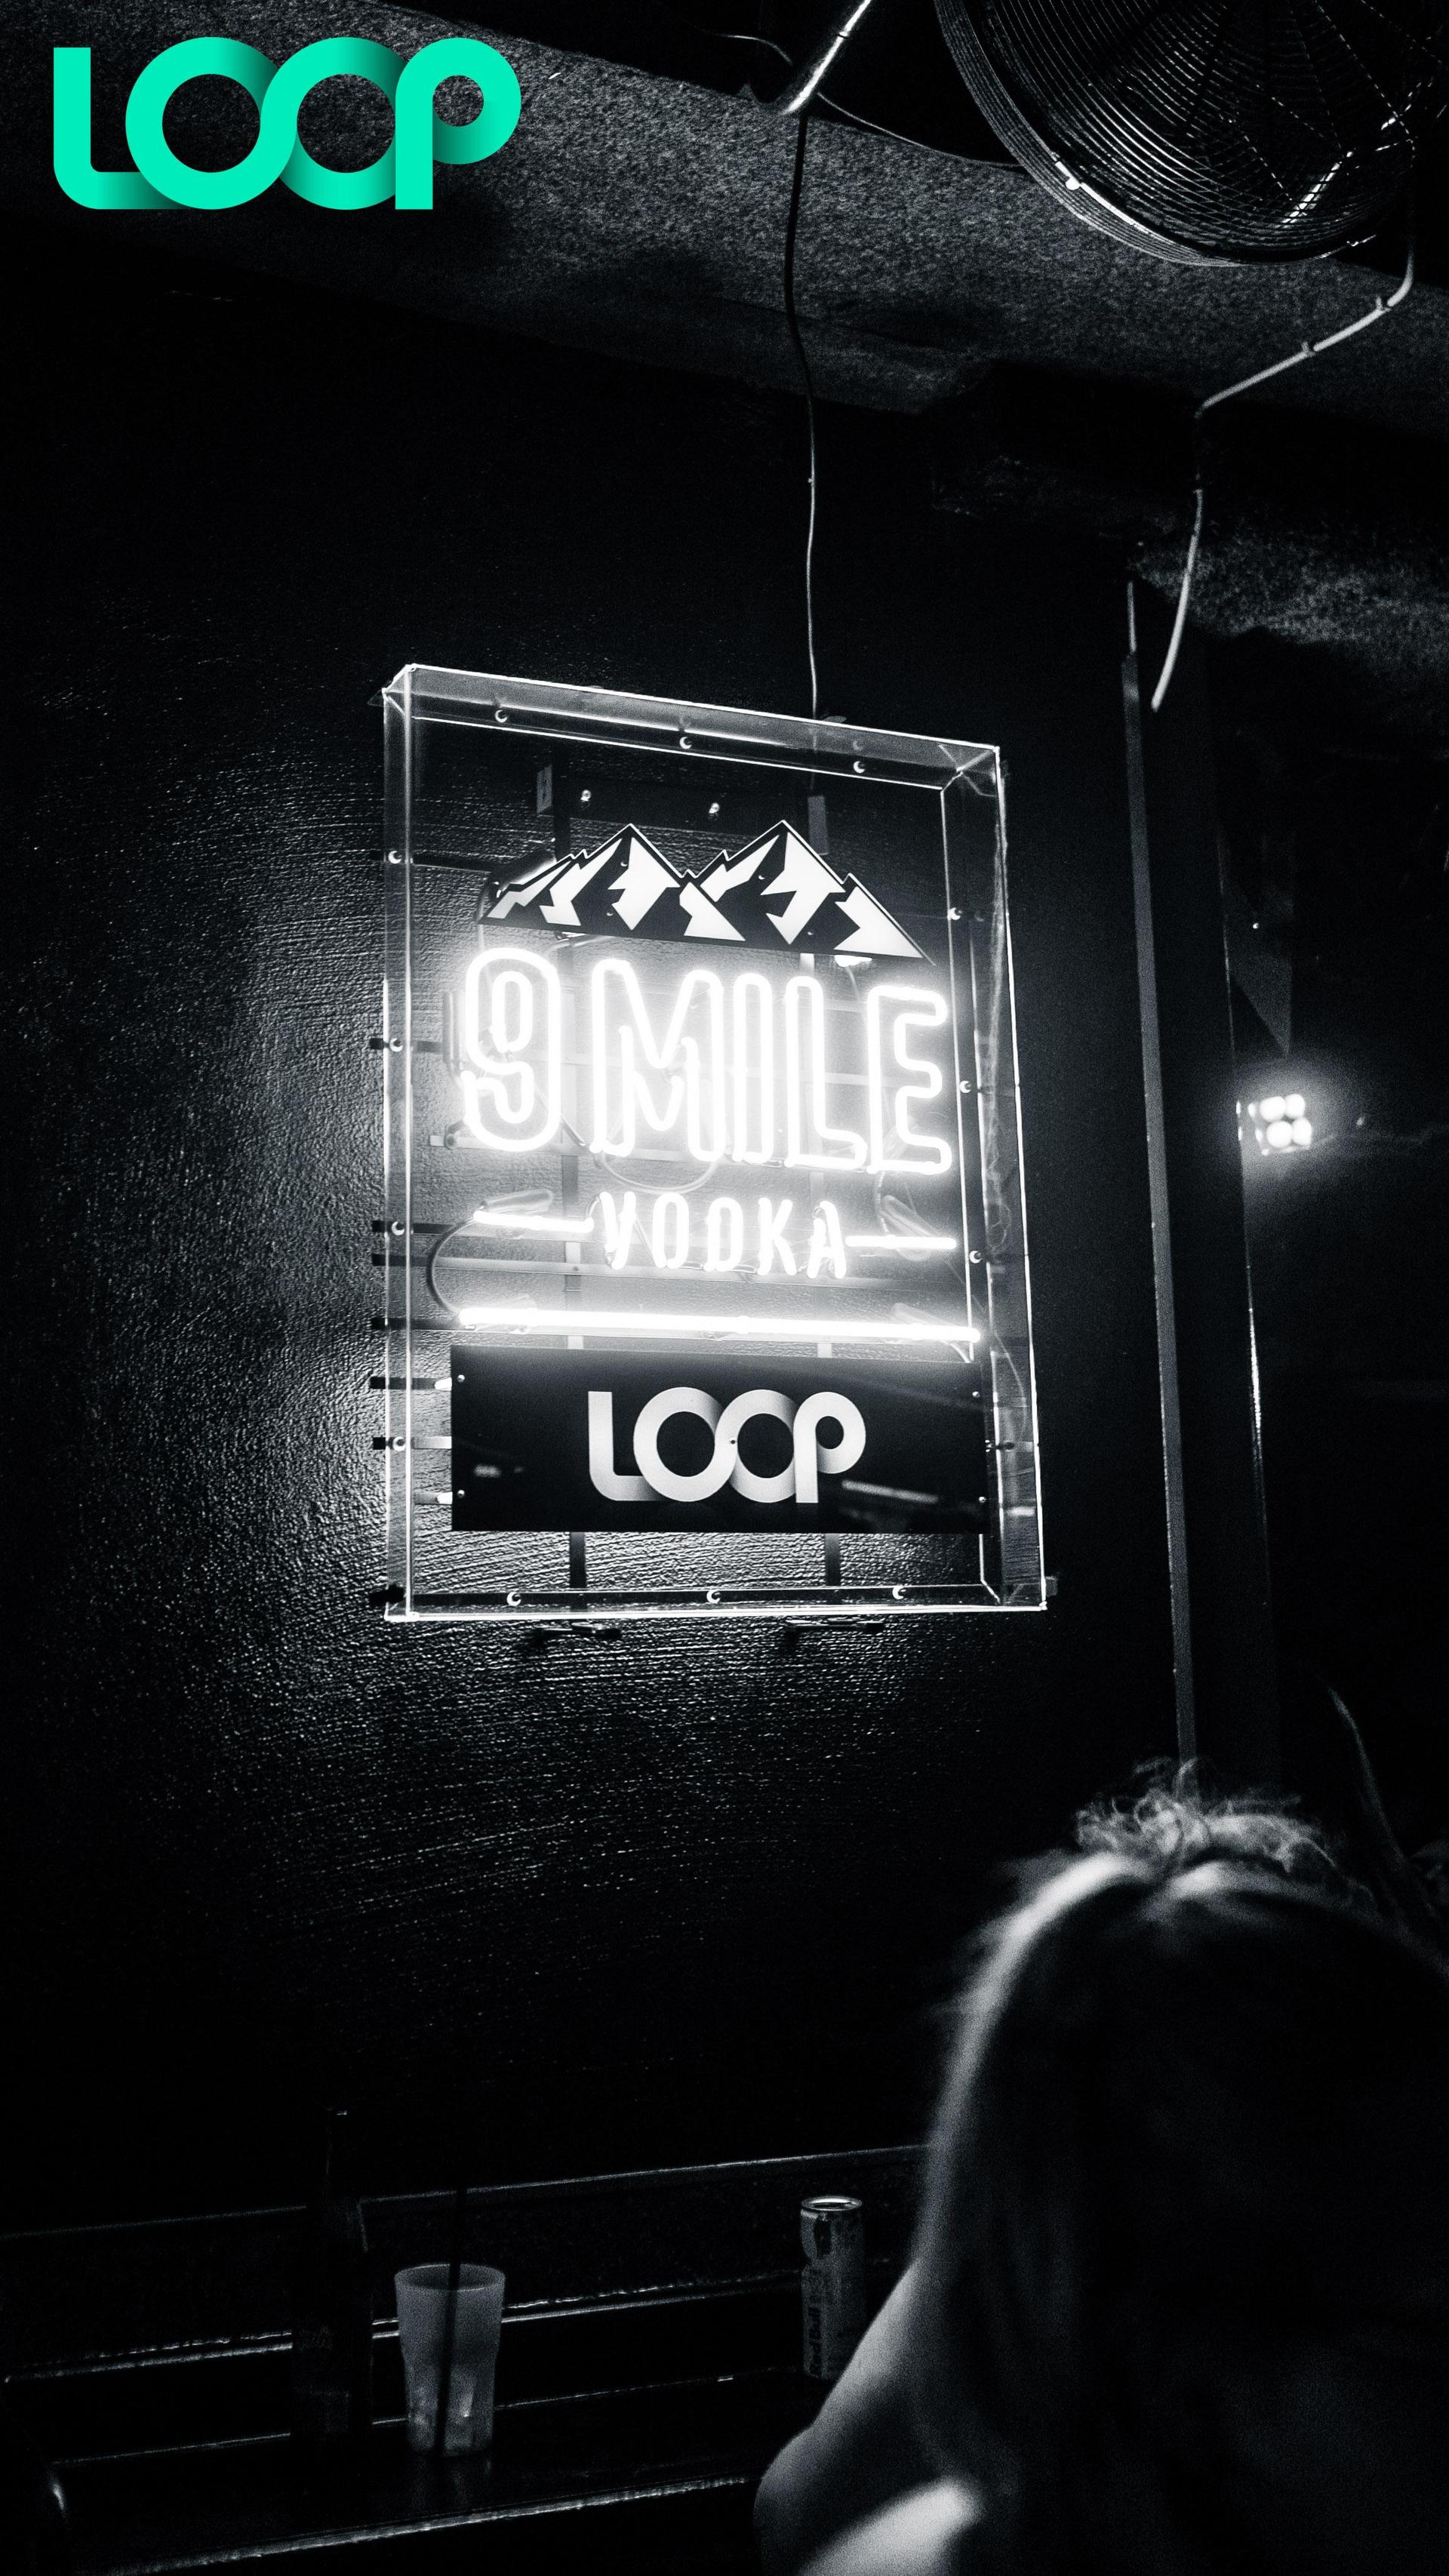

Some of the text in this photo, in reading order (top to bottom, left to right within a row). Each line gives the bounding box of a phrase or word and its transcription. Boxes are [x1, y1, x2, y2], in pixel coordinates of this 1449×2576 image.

[461, 948, 952, 1174] 9 MILE
[599, 1191, 847, 1279] VODKA
[587, 1386, 866, 1503] LOOP
[808, 2307, 822, 2341] Bull
